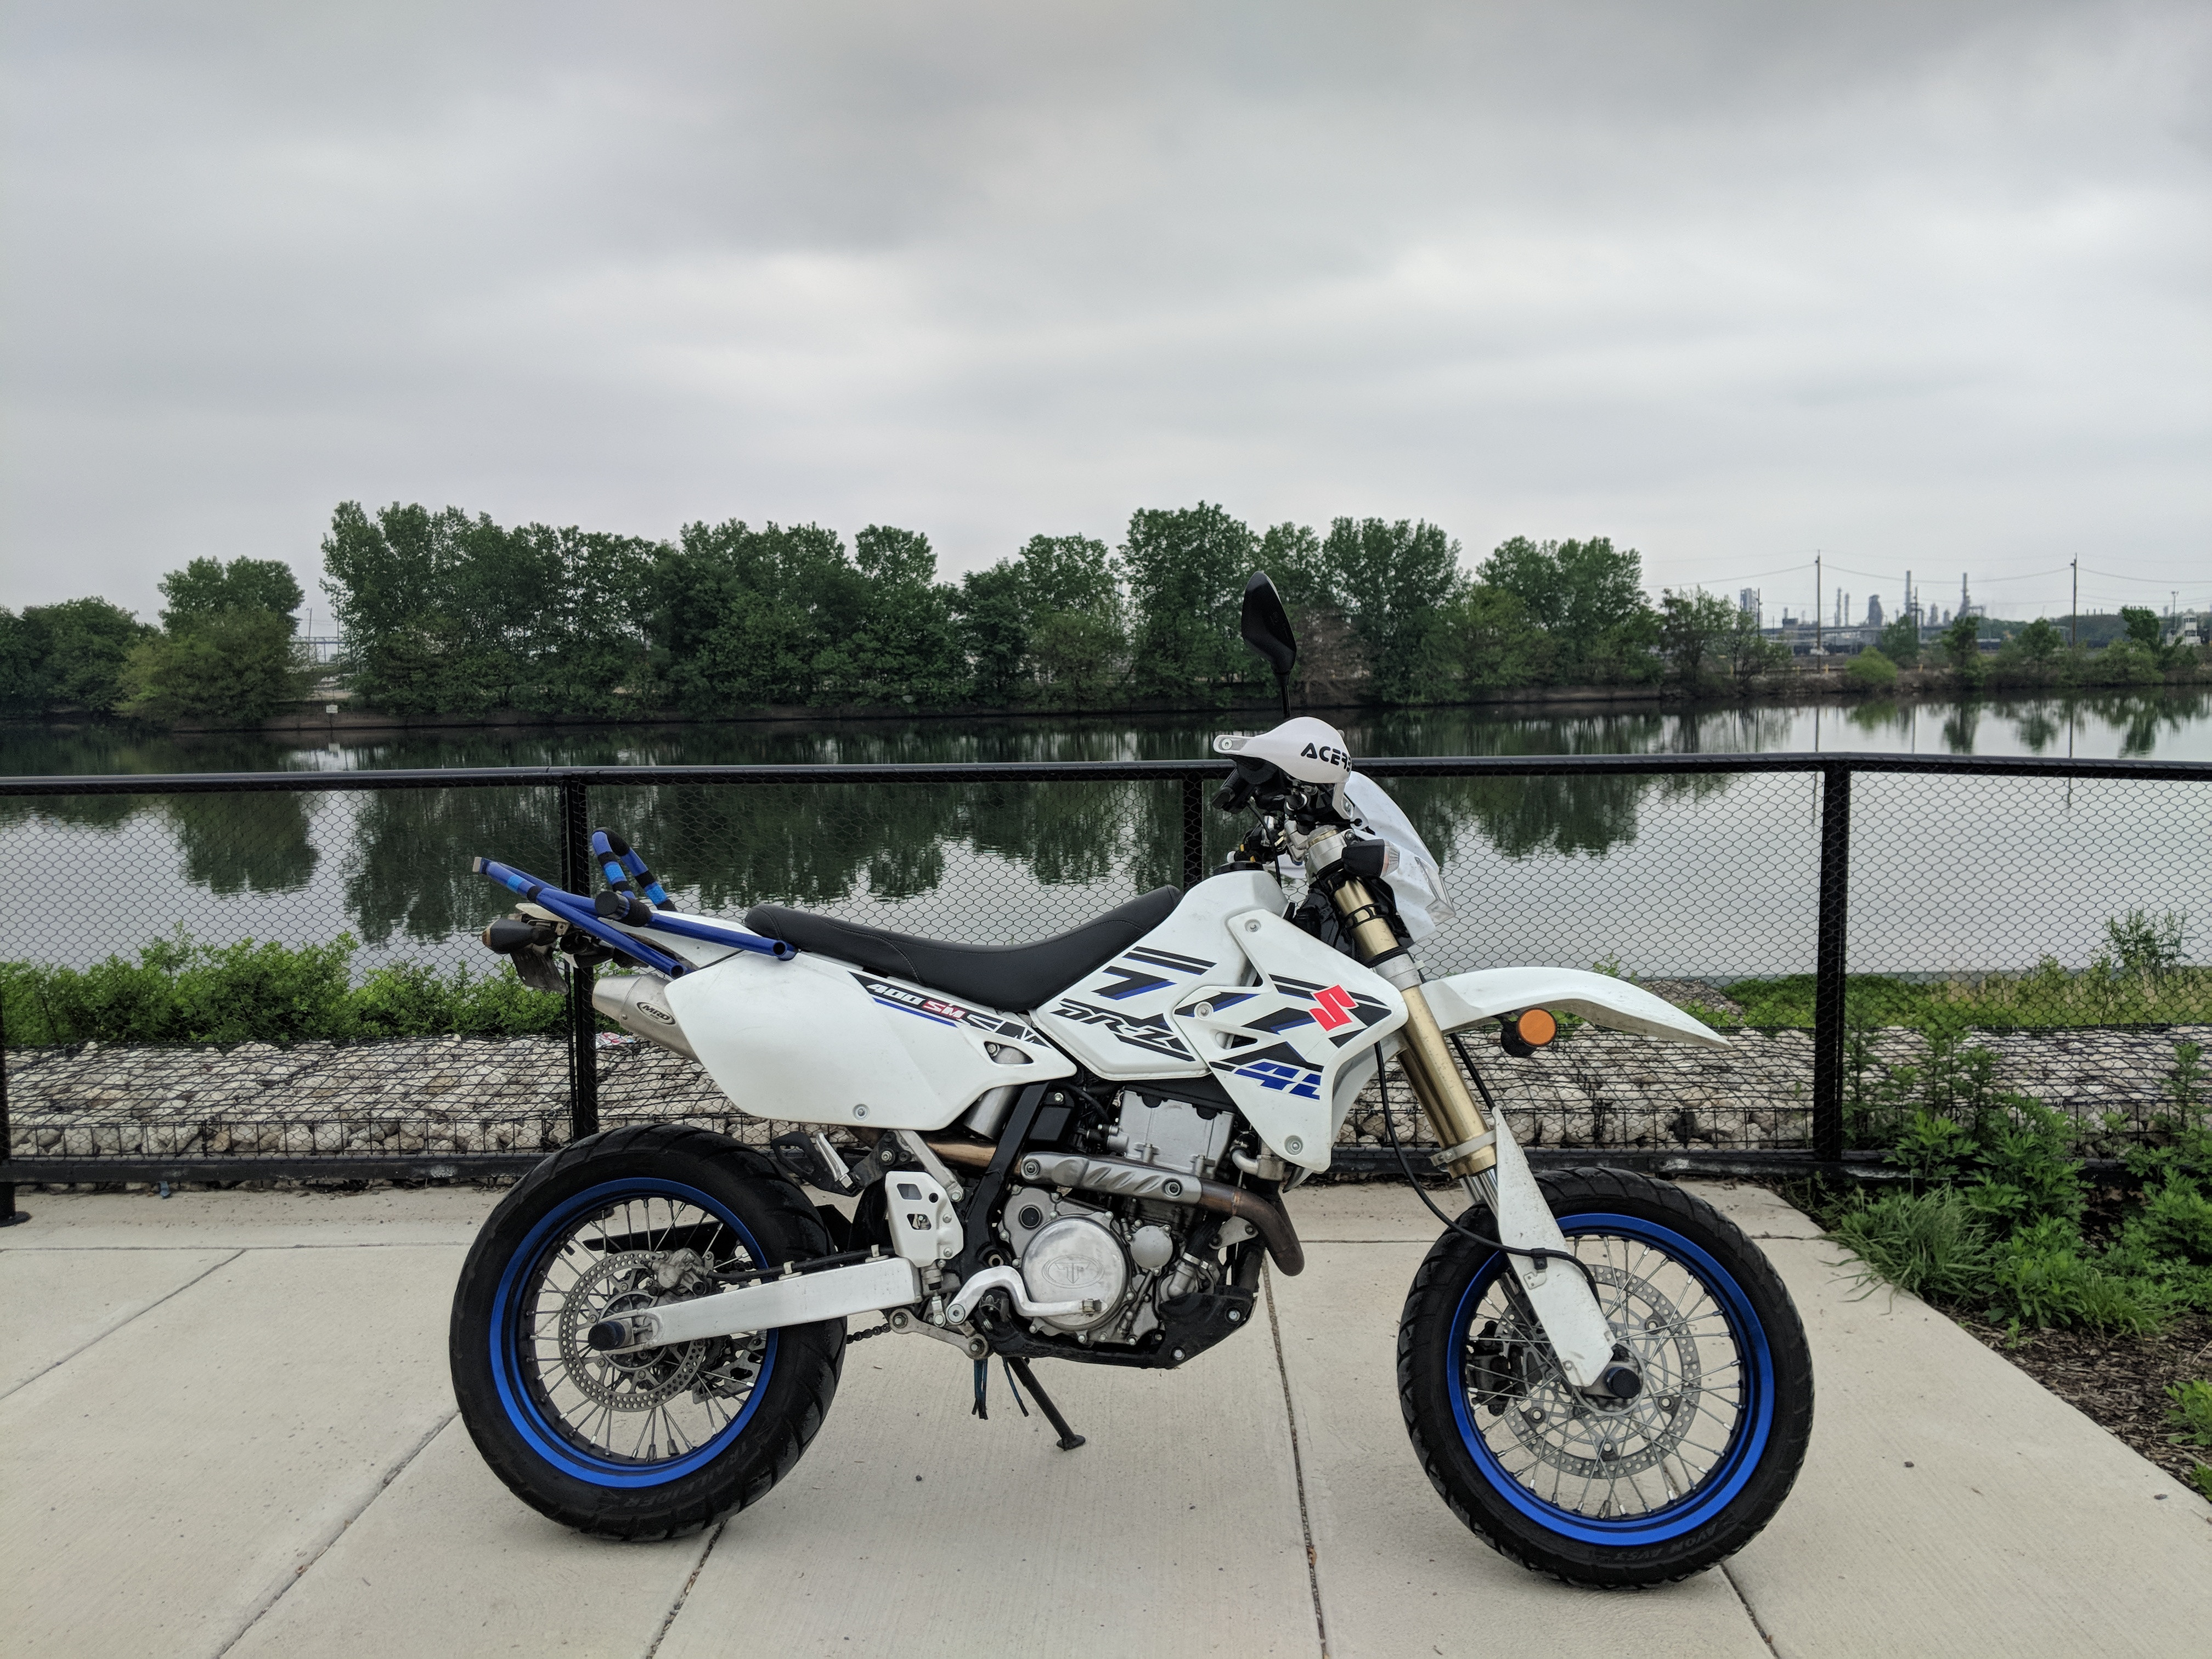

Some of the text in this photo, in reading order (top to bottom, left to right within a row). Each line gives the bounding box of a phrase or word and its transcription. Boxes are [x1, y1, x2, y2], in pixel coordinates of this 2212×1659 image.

[642, 1005, 670, 1020] MRD
[866, 984, 966, 1019] 400 SM
[1668, 1522, 1717, 1554] AVON
